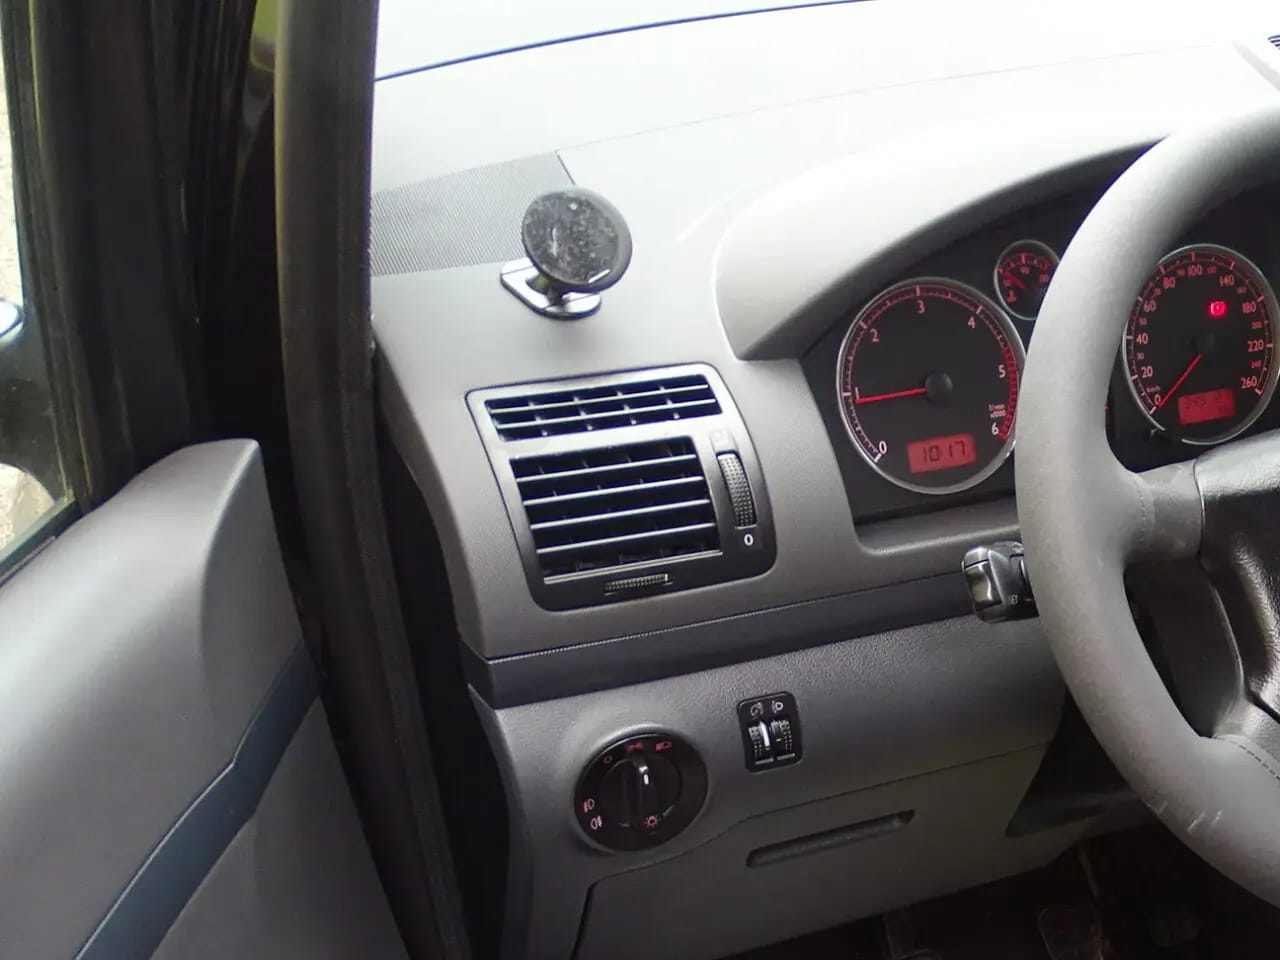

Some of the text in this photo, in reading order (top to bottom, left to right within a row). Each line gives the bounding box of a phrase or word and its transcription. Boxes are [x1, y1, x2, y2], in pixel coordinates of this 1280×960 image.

[1188, 265, 1202, 276] 100
[1163, 276, 1176, 289] 80
[1220, 274, 1235, 286] 140
[917, 301, 925, 314] 3
[1143, 299, 1156, 312] 60
[967, 316, 976, 329] 4
[870, 328, 879, 342] 2
[1136, 332, 1148, 344] 40
[1247, 339, 1264, 352] 220
[998, 364, 1006, 378] 5
[1141, 365, 1153, 378] 20
[1240, 376, 1257, 389] 260
[1154, 394, 1162, 405] 0
[991, 422, 999, 435] 6
[879, 440, 887, 454] 0
